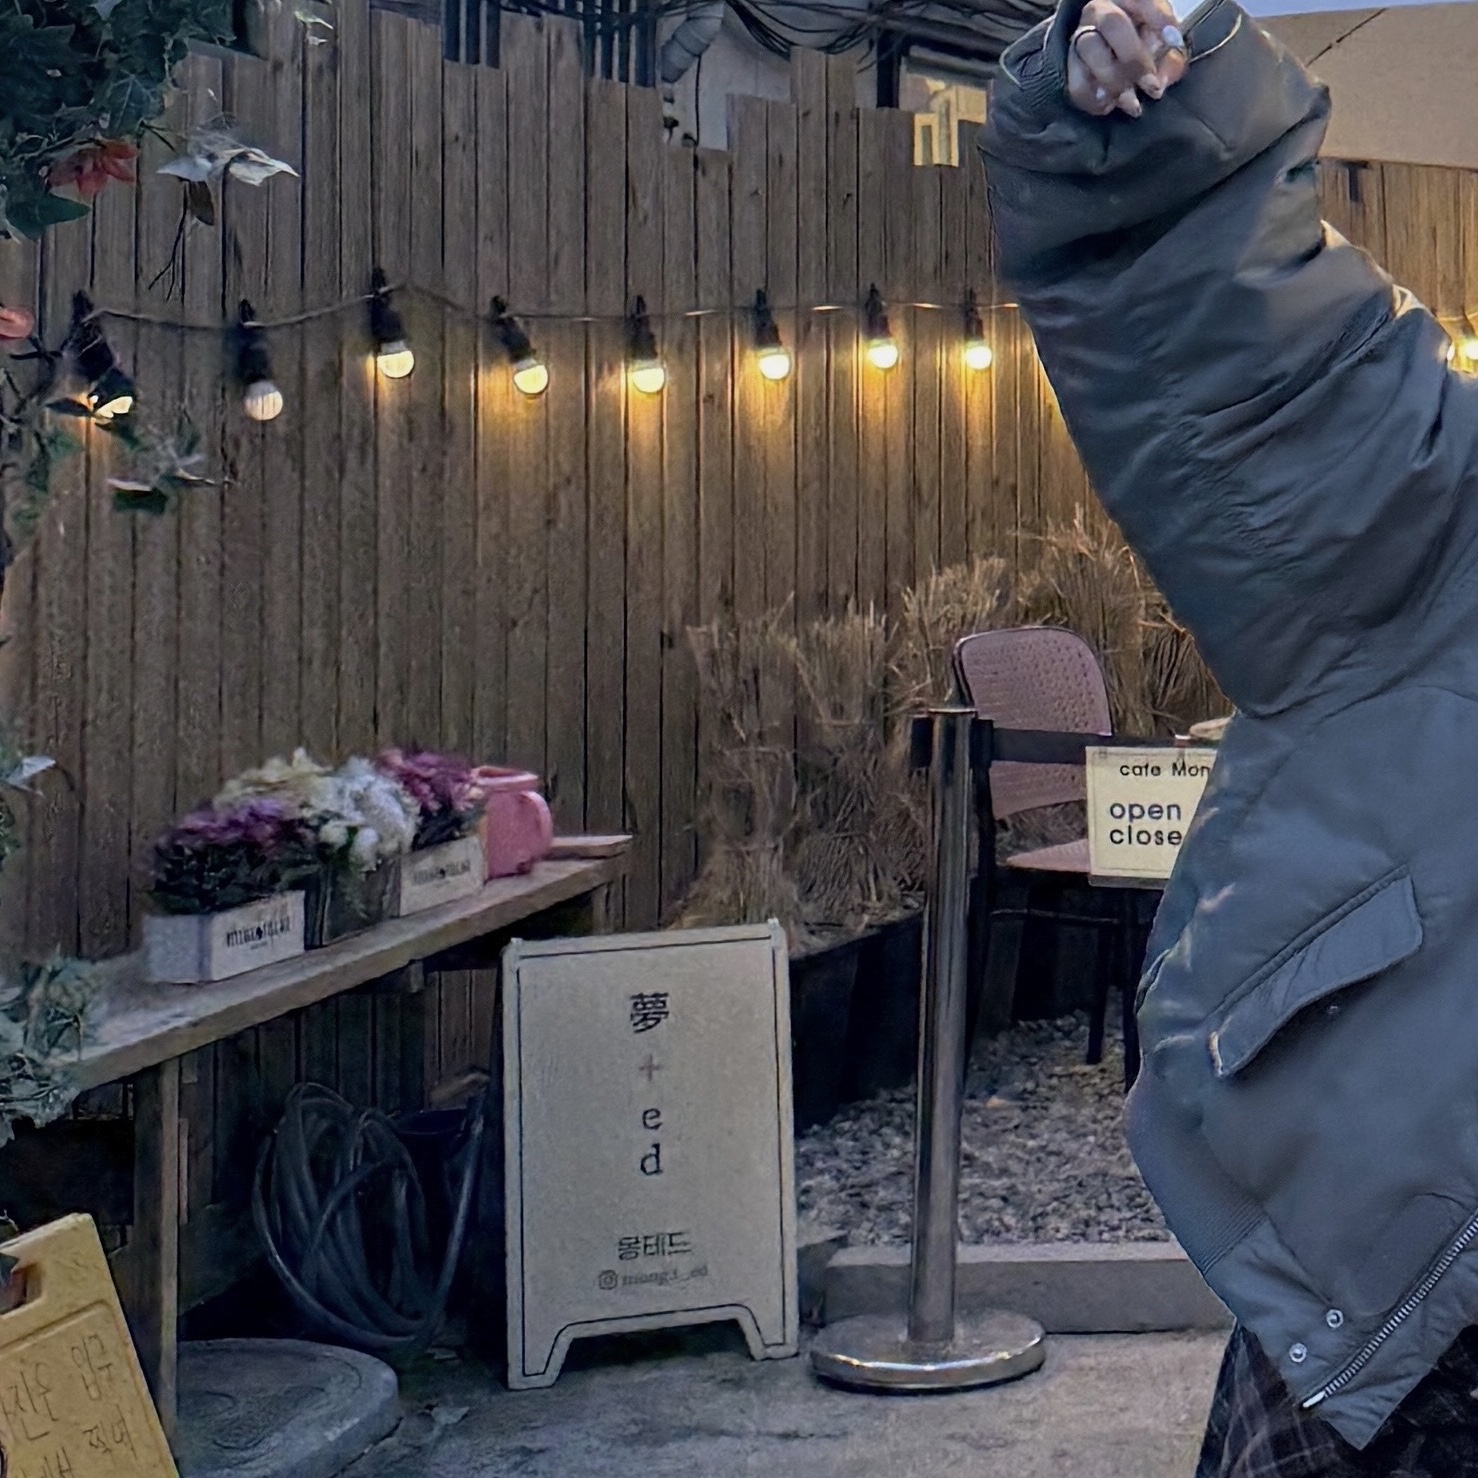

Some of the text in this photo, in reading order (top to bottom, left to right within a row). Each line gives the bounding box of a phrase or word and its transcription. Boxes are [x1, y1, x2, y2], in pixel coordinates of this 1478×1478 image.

[1119, 763, 1162, 777] cafe
[1109, 802, 1182, 823] open
[1109, 824, 1183, 846] close
[617, 1230, 693, 1261] 몽테드
[70, 1334, 114, 1402] 입구
